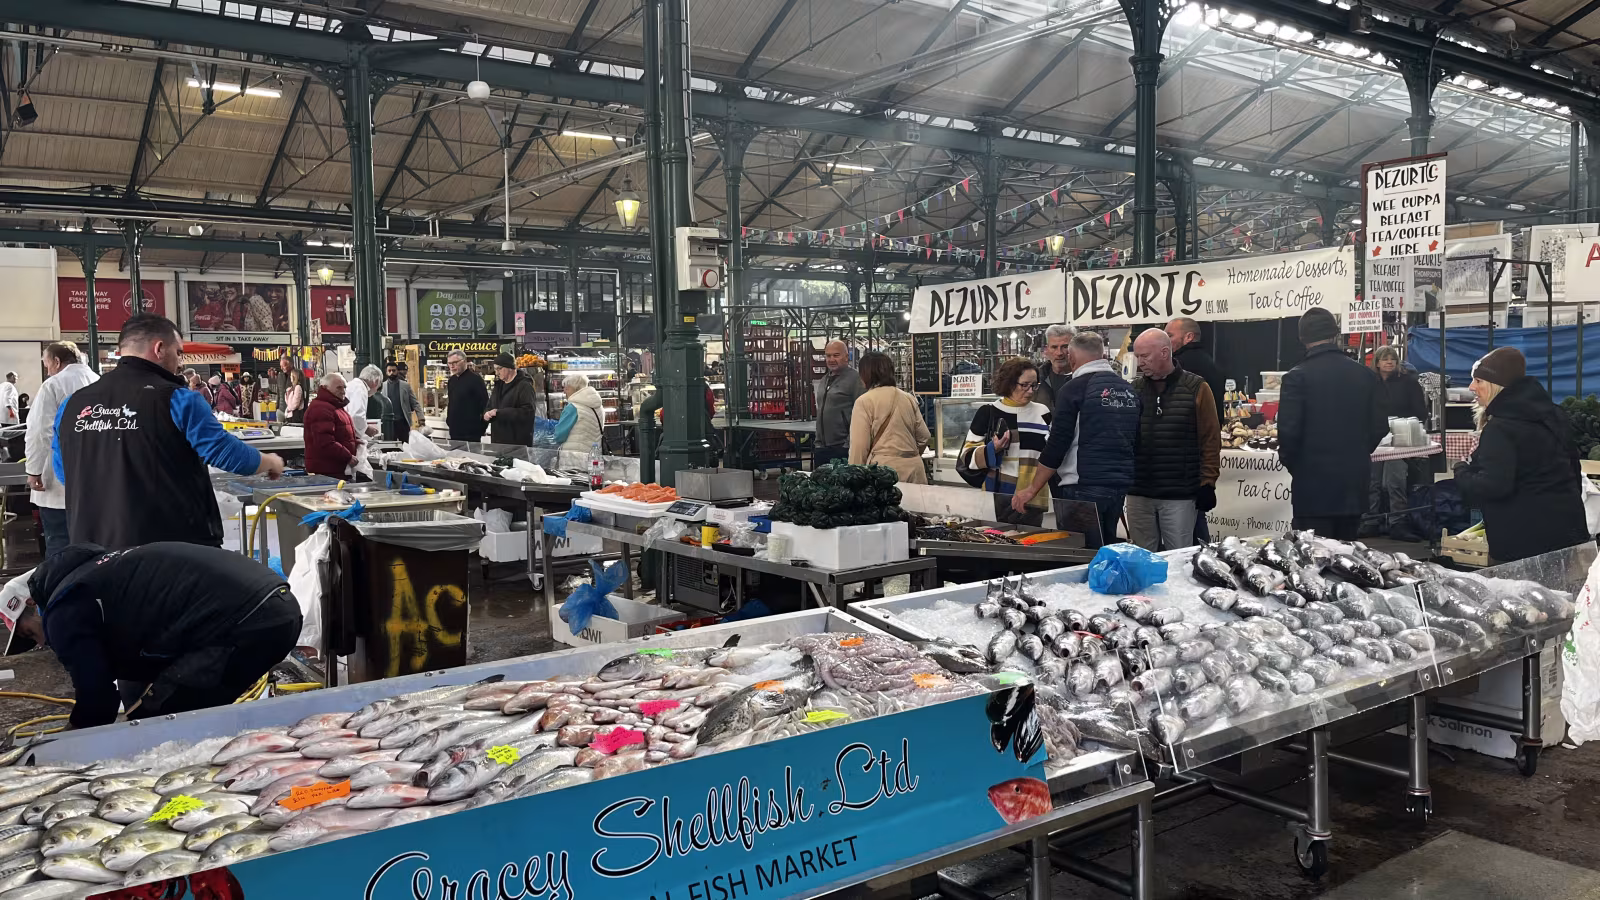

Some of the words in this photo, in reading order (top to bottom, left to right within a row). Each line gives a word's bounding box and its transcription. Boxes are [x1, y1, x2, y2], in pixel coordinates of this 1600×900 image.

[1375, 164, 1438, 190] DEZURTS
[1372, 199, 1396, 212] WEE
[1402, 193, 1440, 208] CUPPA
[1380, 210, 1431, 226] BELFAST
[1370, 224, 1441, 242] TEA/COFFEE
[1391, 243, 1419, 256] HERE
[1227, 260, 1294, 285] Homemade
[1296, 256, 1348, 279] Desserts,
[1373, 264, 1400, 277] BELFAST
[1073, 271, 1201, 320] DEZURTS
[1369, 280, 1405, 293] TEA/COFFEE
[929, 281, 1030, 327] DEZURTS
[1249, 291, 1274, 310] Tea
[1274, 290, 1283, 308] &
[1287, 286, 1324, 310] Coffee
[1349, 300, 1381, 312] DEZURTS
[428, 340, 498, 352] Currysauce
[90, 403, 121, 419] Gracey
[74, 419, 113, 433] Shellfish
[114, 417, 139, 430] Ltd
[1219, 453, 1283, 472] omemade
[1237, 479, 1261, 497] Tea
[1261, 481, 1271, 501] &
[1274, 482, 1292, 501] Co
[1206, 512, 1219, 525] ake
[1220, 517, 1240, 531] away
[1246, 516, 1274, 530] Phone:
[1438, 717, 1493, 739] Salmon
[590, 766, 815, 878] Shellfish
[829, 738, 919, 815] Ltd
[688, 868, 748, 900] FISH
[754, 835, 858, 891] MARKET
